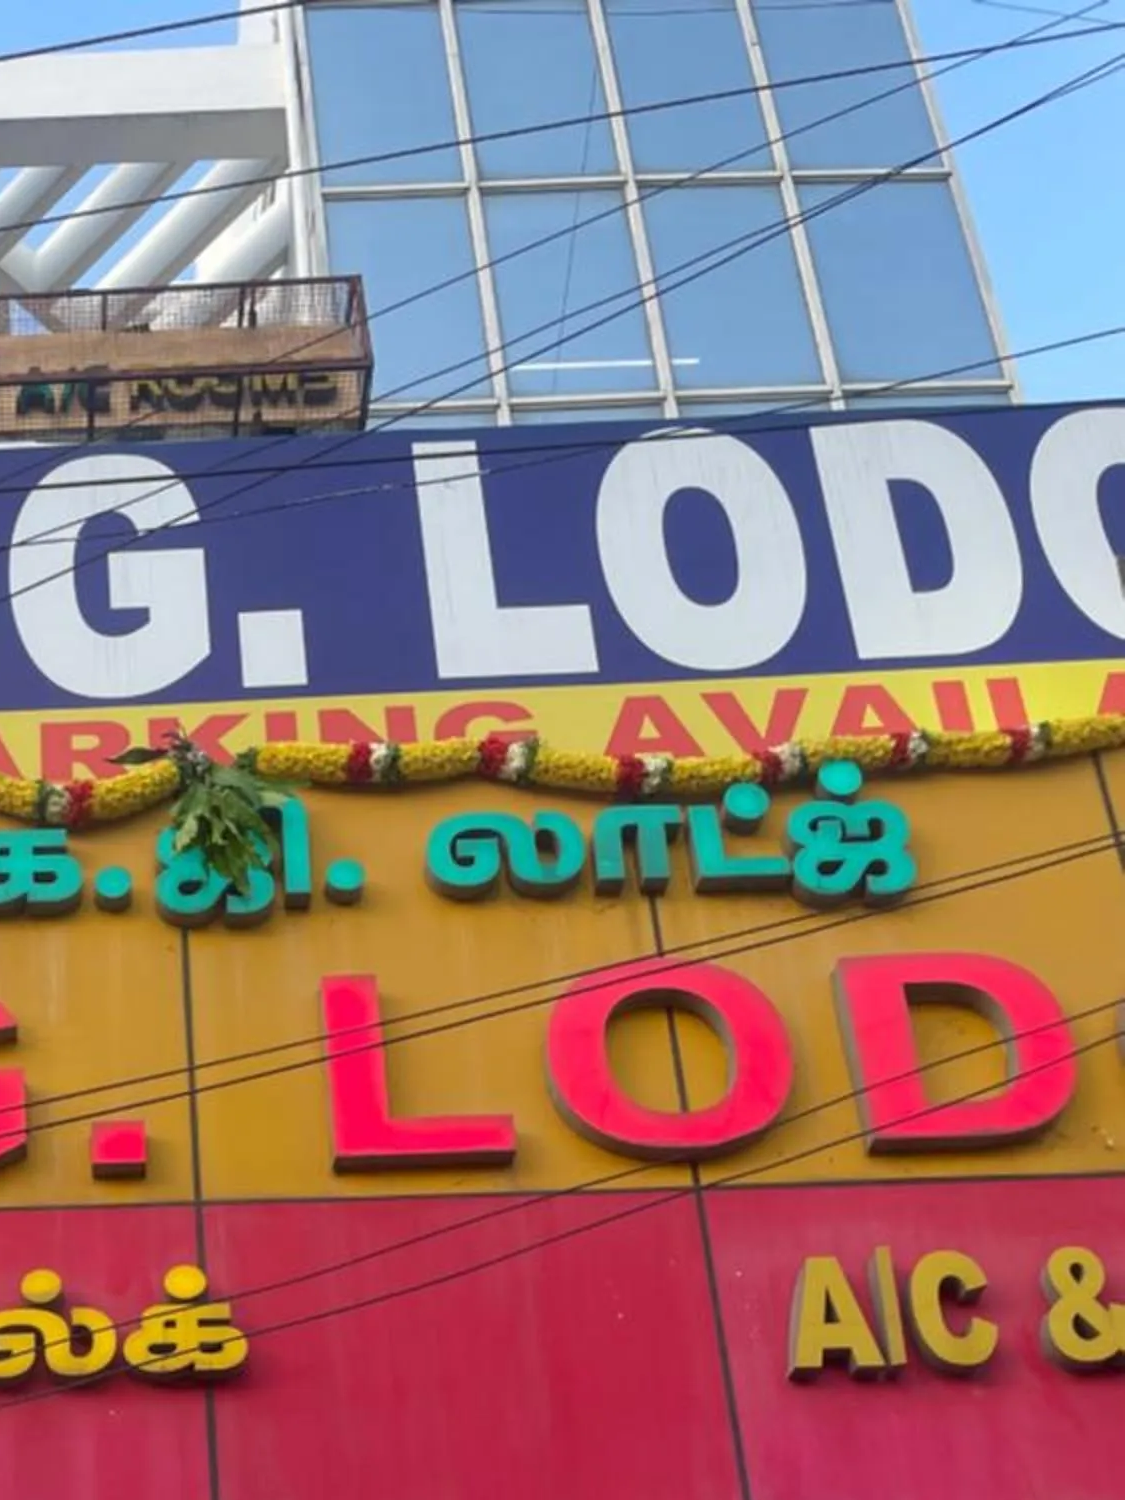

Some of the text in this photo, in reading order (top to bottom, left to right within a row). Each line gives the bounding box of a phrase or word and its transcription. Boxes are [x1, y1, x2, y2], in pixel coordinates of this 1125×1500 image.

[425, 759, 916, 908] லாட்ஜ்
[322, 952, 1125, 1170] LOD
[788, 1246, 1125, 1380] A/C &
